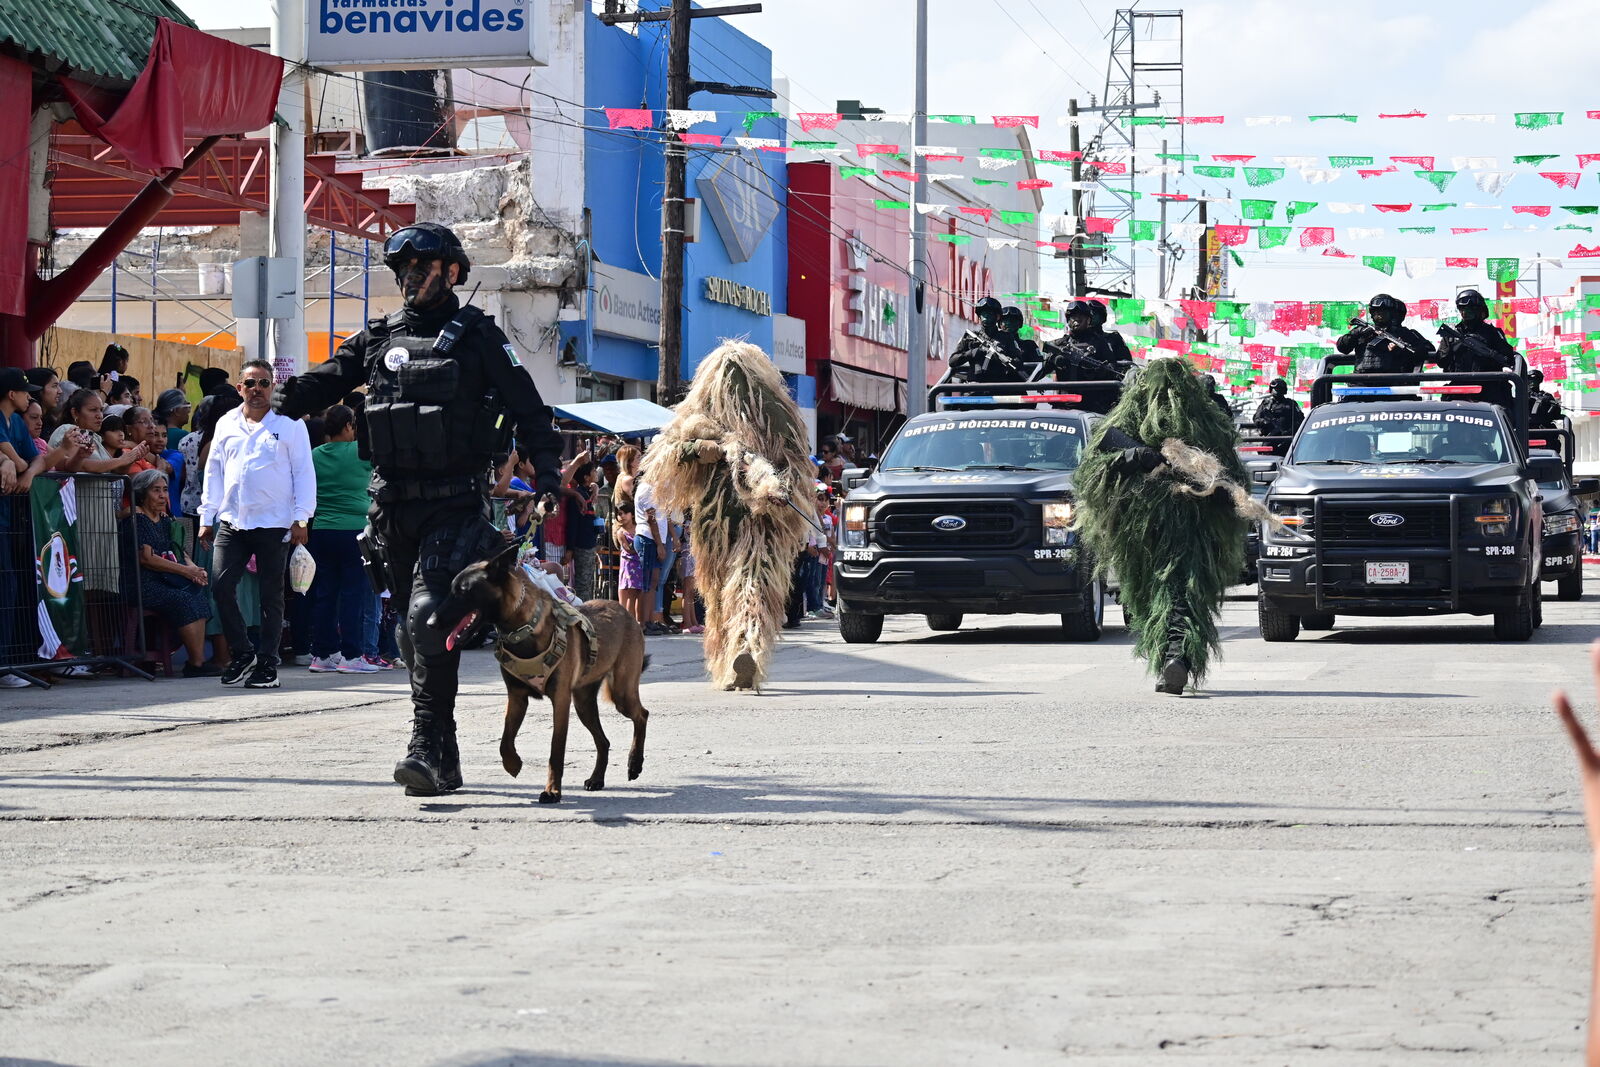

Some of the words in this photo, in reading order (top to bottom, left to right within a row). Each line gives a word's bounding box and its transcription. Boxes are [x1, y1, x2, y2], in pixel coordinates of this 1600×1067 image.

[320, 0, 524, 34] benavides
[705, 275, 741, 308] SALINAS
[745, 284, 772, 317] ROCHA
[613, 293, 637, 319] Banco
[638, 301, 661, 325] Azteca
[785, 338, 804, 359] Azteca
[1377, 516, 1398, 525] Ford
[843, 551, 874, 561] SPR-263
[1266, 546, 1293, 557] SPR-264
[1485, 545, 1515, 556] SPR-264
